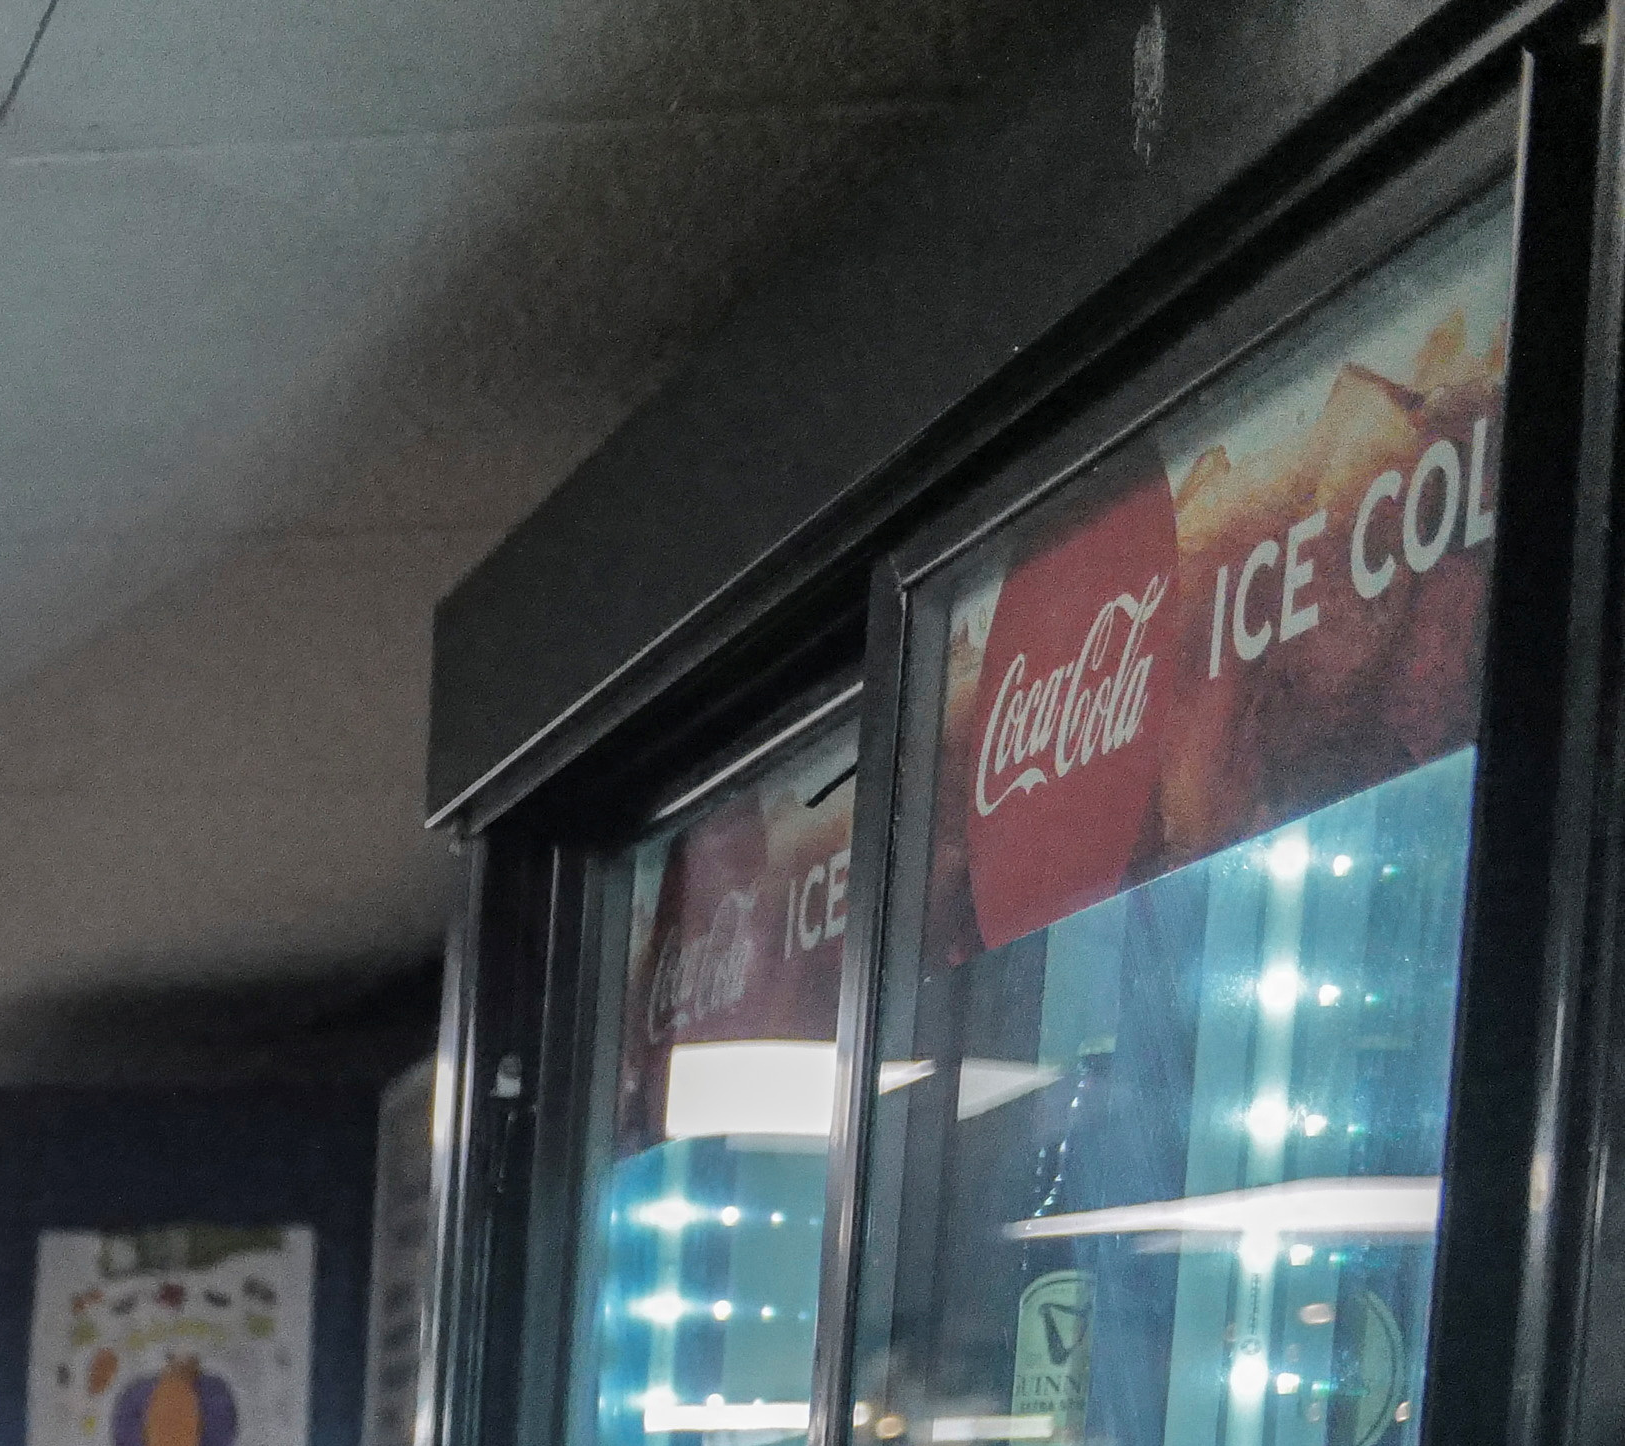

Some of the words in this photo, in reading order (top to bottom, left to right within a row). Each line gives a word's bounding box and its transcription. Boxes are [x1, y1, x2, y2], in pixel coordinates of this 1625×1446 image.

[1208, 508, 1326, 680] ICE
[975, 574, 1167, 817] Coca-Cola
[783, 847, 852, 961] ICE
